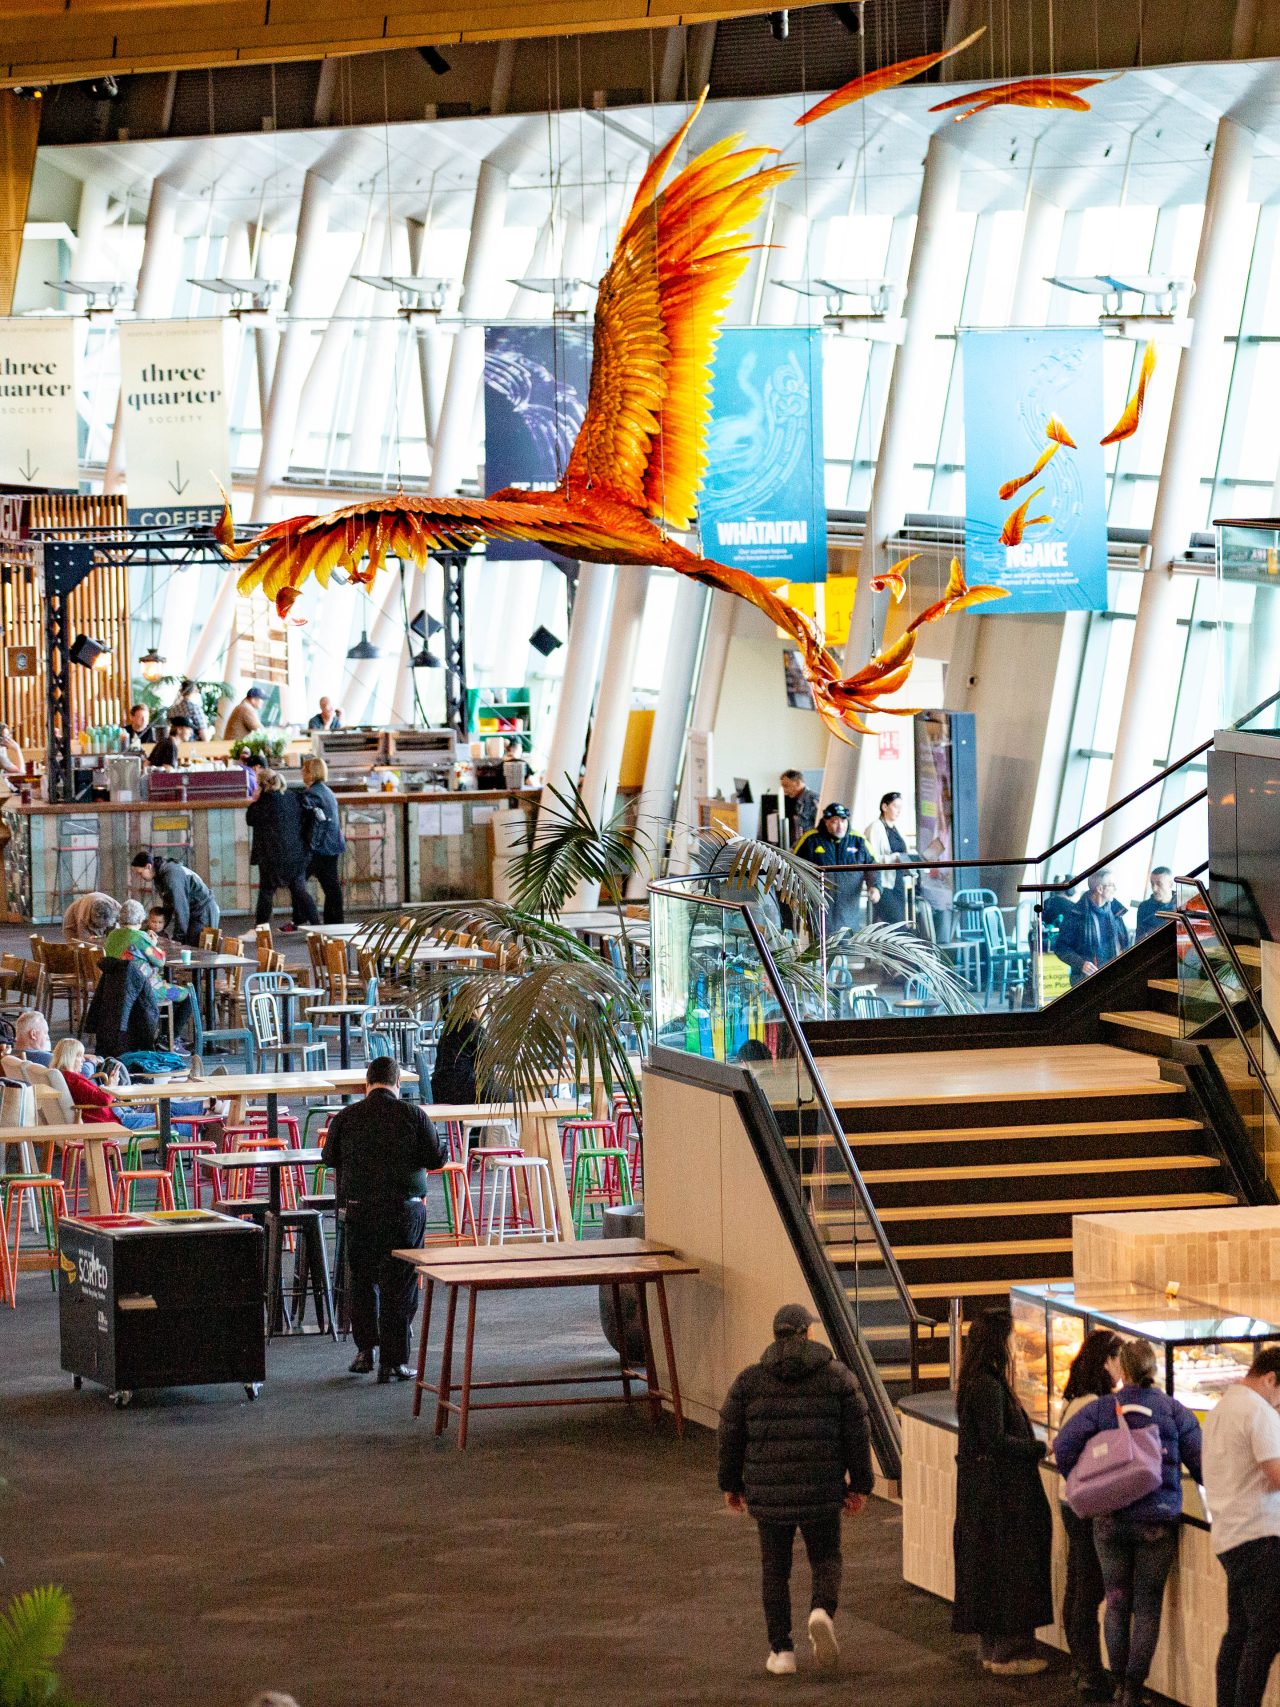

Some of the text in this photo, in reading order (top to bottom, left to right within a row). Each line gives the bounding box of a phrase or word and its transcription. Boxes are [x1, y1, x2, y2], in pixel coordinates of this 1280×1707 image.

[142, 364, 206, 382] three
[0, 384, 71, 397] uarter
[128, 389, 221, 411] quarter
[140, 509, 222, 526] COFFEE
[1005, 542, 1068, 568] NGAKE
